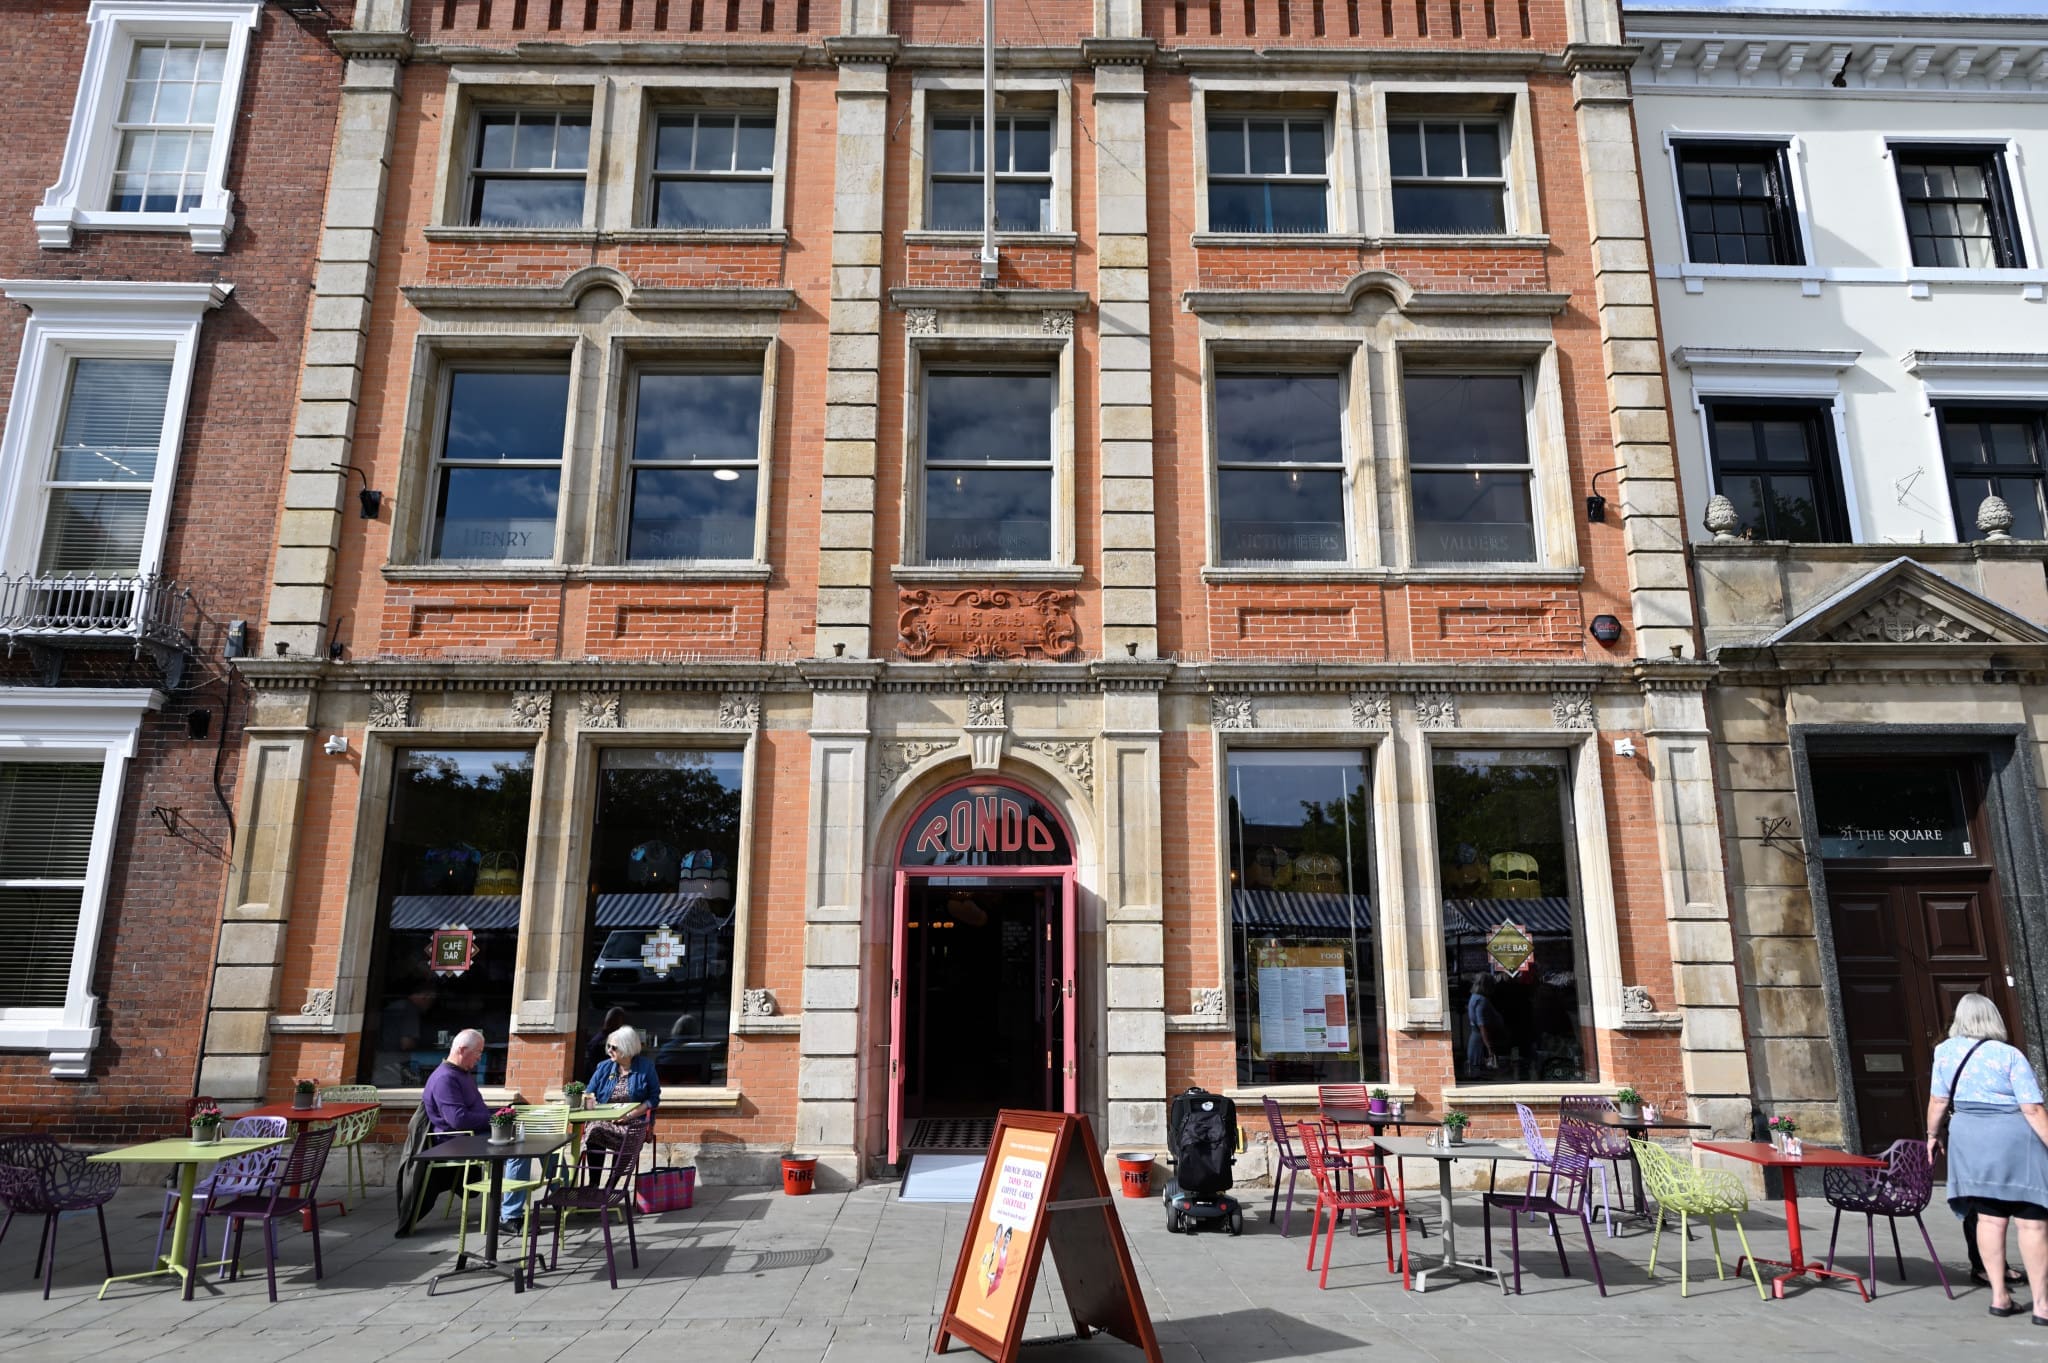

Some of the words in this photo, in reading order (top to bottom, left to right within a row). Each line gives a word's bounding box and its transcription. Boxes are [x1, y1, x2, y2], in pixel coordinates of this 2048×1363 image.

[464, 527, 532, 547] HENRY
[1439, 535, 1510, 552] VALUERS
[917, 797, 1055, 852] RONDO
[1841, 829, 1852, 841] 21
[1856, 829, 1885, 841] THE
[1889, 829, 1943, 844] SQUARE
[442, 940, 462, 950] CAFÉ
[1512, 944, 1528, 952] BAR
[444, 952, 458, 960] BAR
[1320, 952, 1342, 960] FOOD
[788, 1170, 814, 1182] FIRE
[1124, 1171, 1149, 1184] FIRE
[1001, 1186, 1018, 1196] COFFEE
[1003, 1197, 1026, 1210] COCKTAILS
